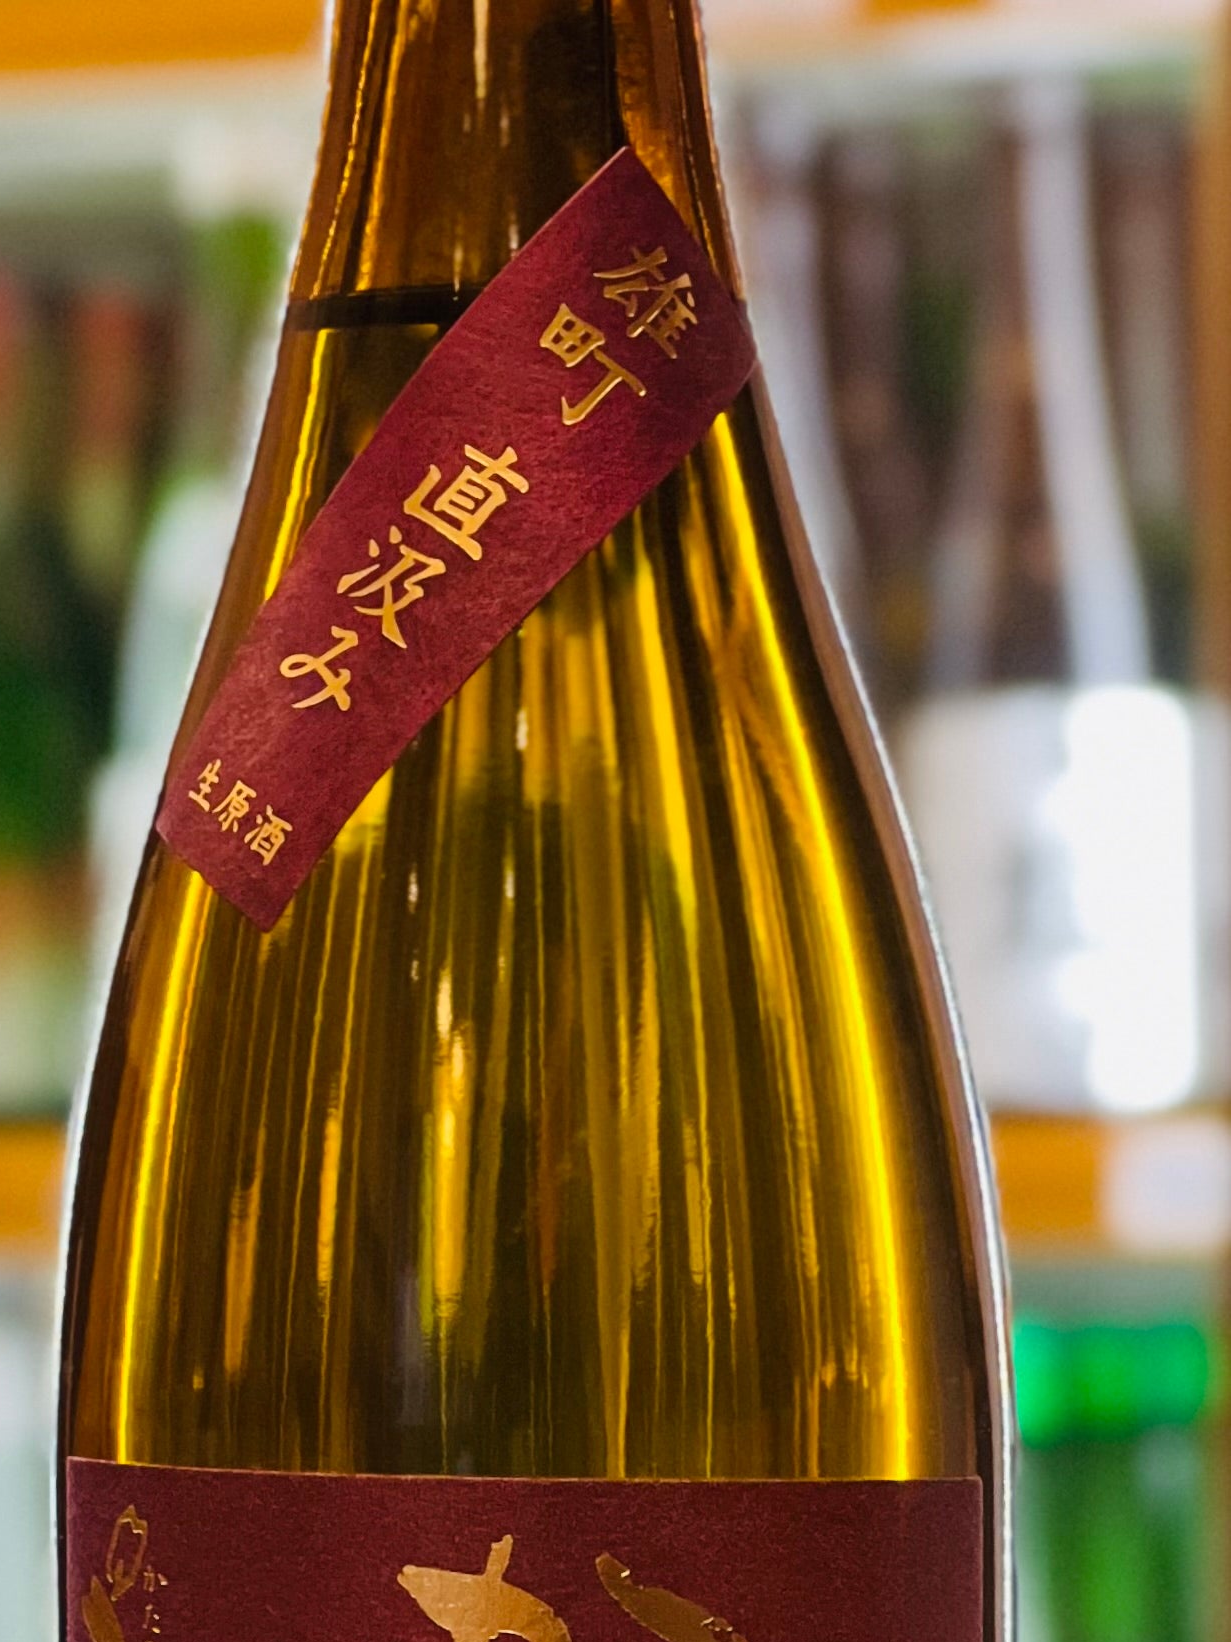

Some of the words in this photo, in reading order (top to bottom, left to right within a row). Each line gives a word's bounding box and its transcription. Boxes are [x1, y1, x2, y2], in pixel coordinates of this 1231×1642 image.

[539, 245, 699, 427] 雄町
[278, 443, 531, 713] 直汲み
[188, 758, 294, 867] 生原酒
